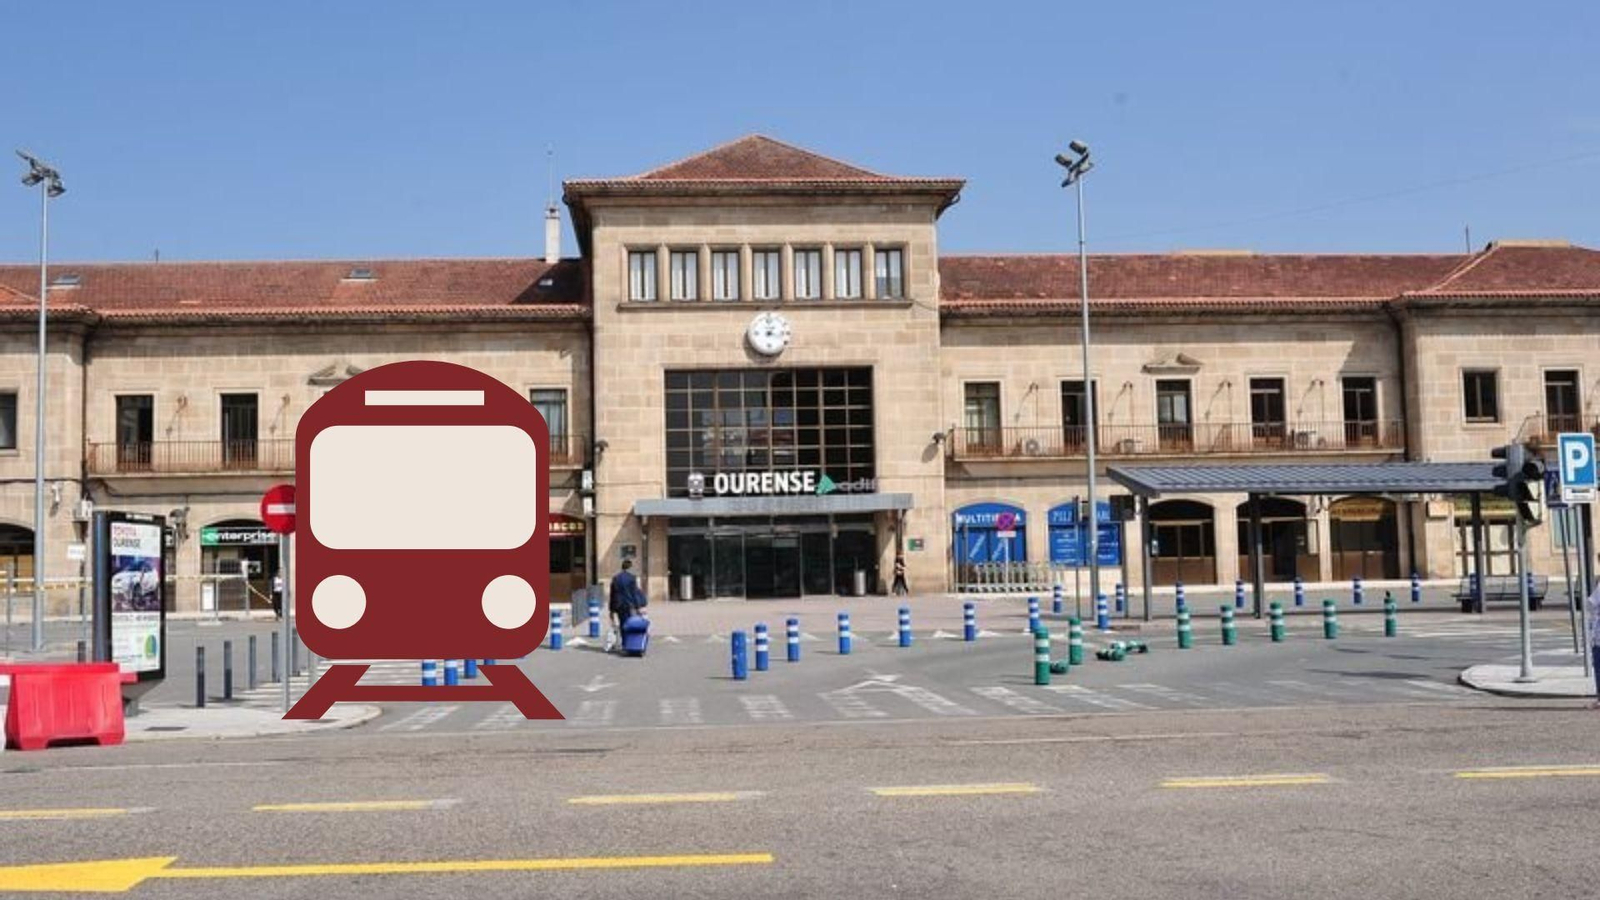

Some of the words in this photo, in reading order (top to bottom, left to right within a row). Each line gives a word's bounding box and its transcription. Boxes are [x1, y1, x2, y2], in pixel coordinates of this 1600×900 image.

[1564, 440, 1589, 482] P
[713, 471, 815, 494] OURENSE
[203, 530, 277, 542] enterprise
